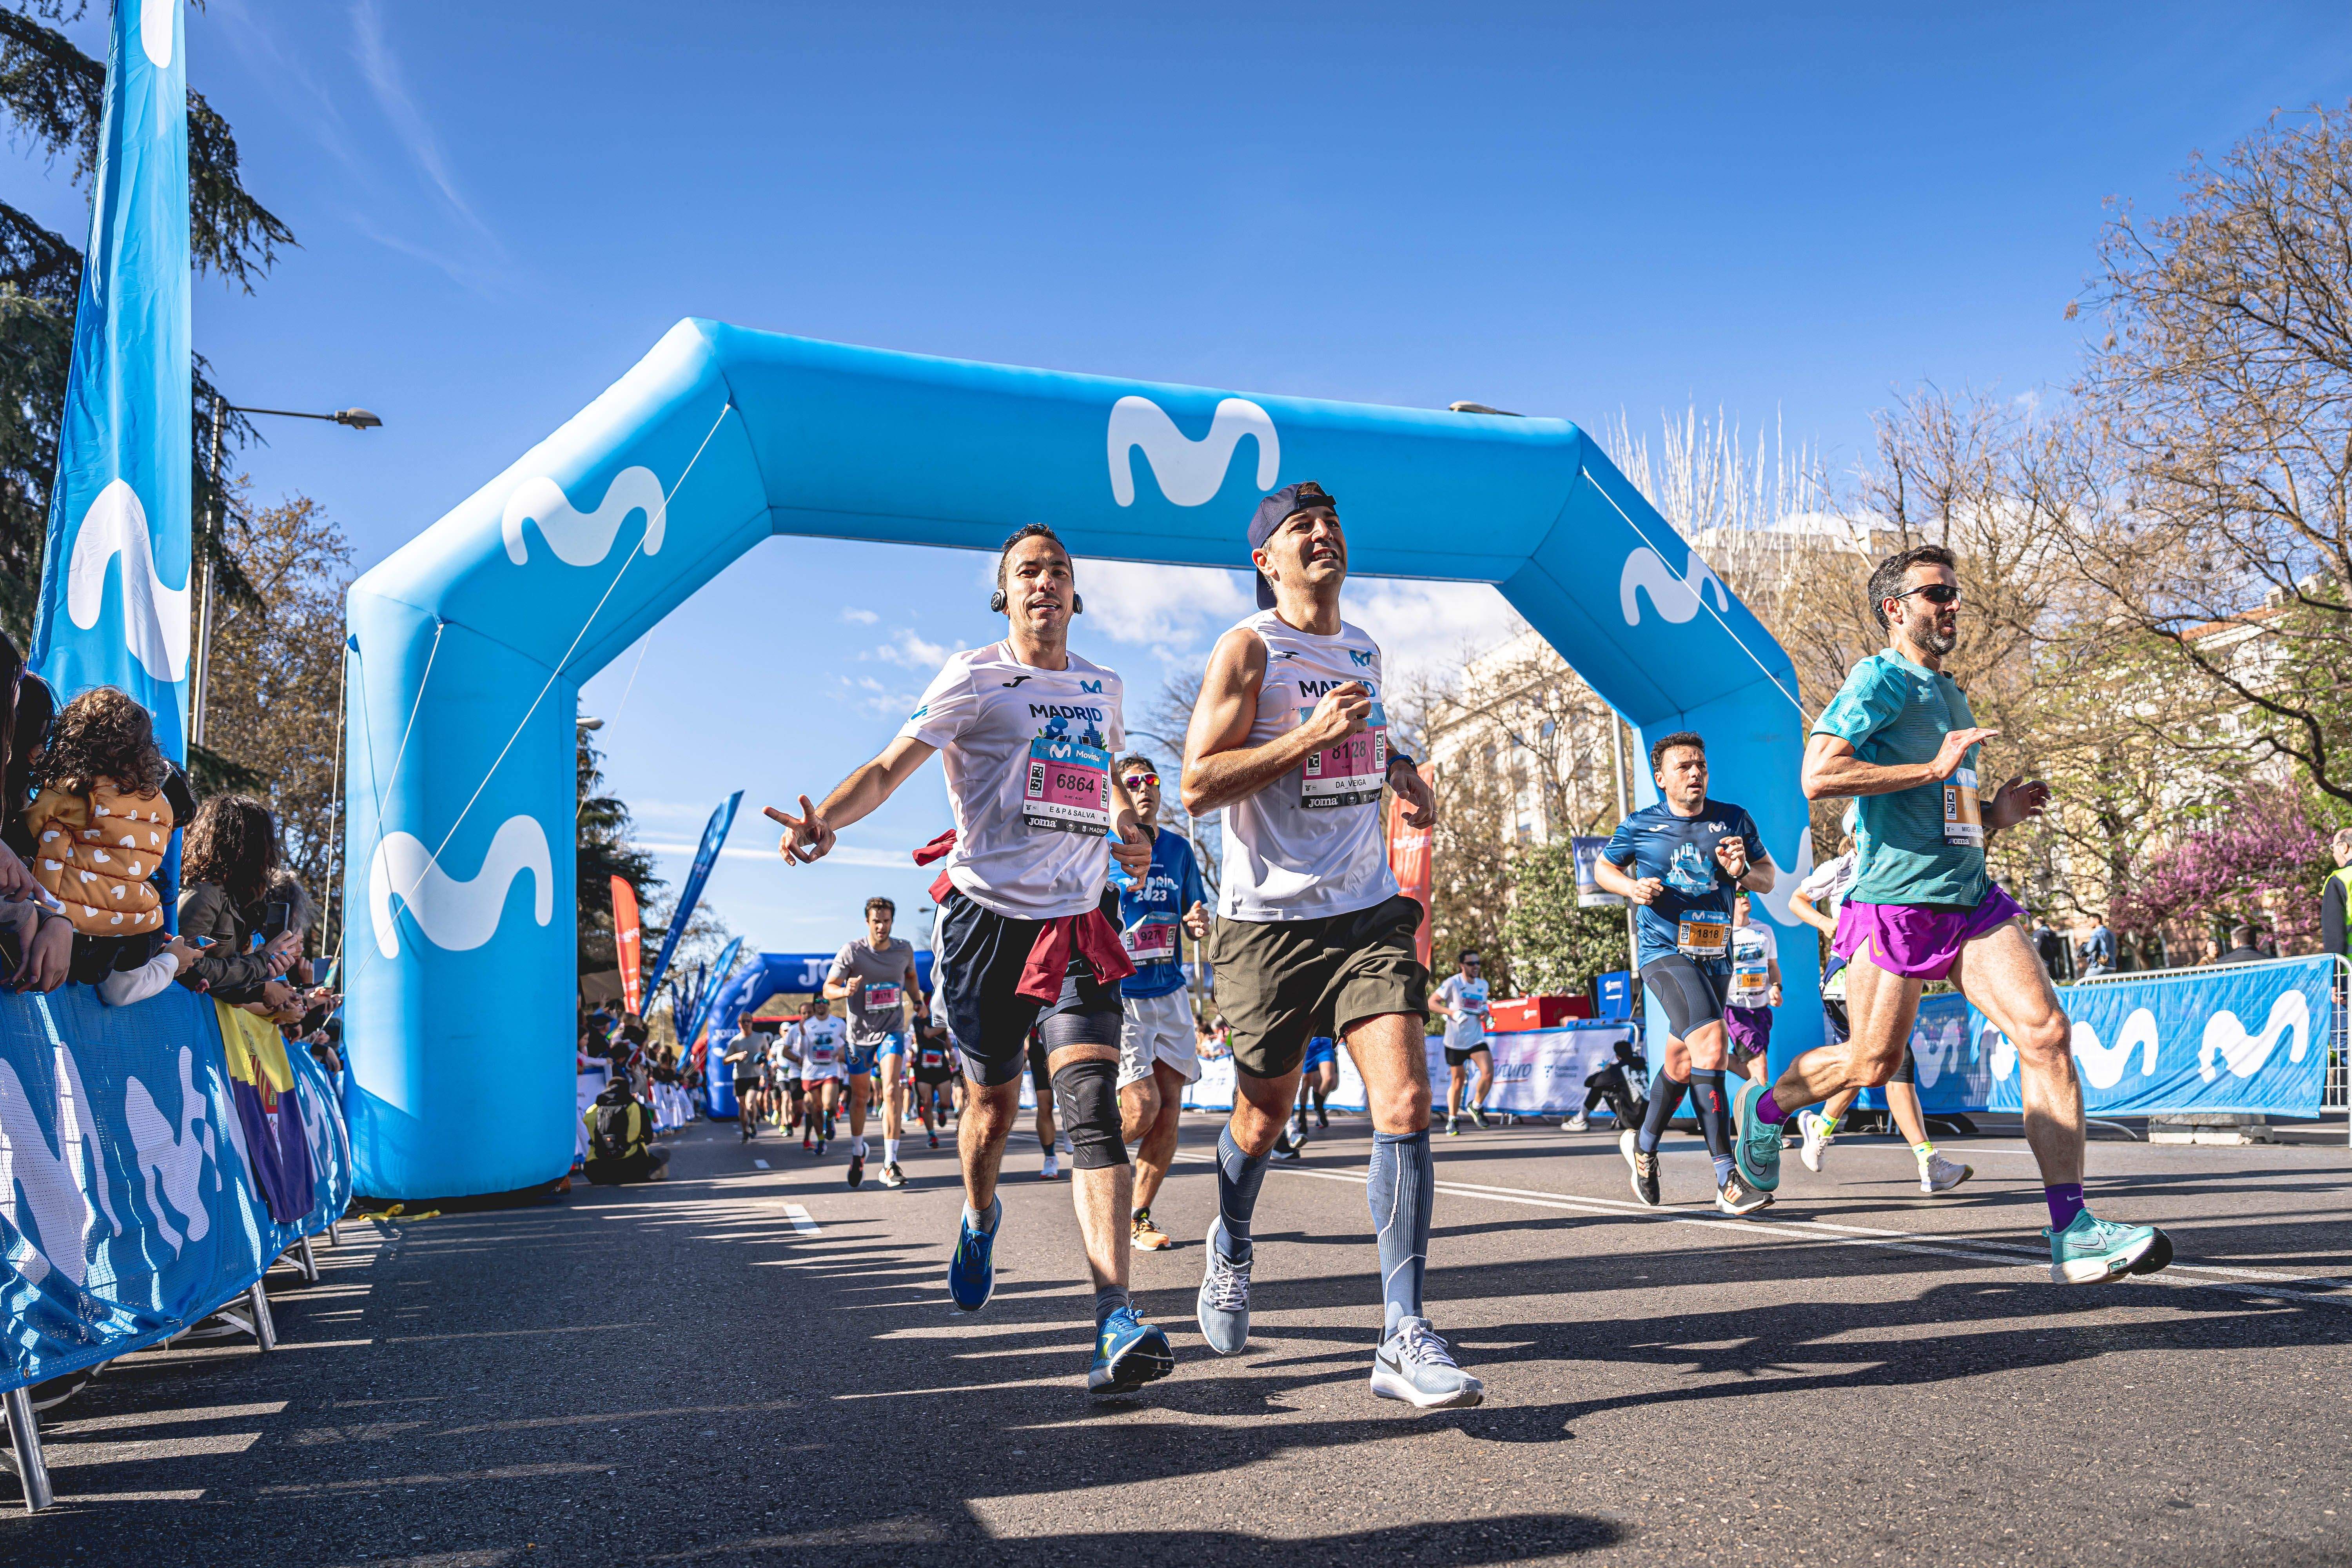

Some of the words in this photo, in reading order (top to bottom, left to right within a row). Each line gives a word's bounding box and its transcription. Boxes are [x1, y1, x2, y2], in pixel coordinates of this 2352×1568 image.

[1298, 681, 1376, 697] MAD
[1029, 704, 1103, 722] MADRID
[1076, 750, 1100, 762] Movistar
[1332, 740, 1366, 760] 8128
[1056, 773, 1094, 793] 6864
[1336, 779, 1367, 789] DA_VEIGA
[1369, 791, 1381, 800] MADR
[1073, 810, 1095, 819] SALVA
[1697, 929, 1719, 938] 1818
[1493, 1058, 1532, 1078] uturo
